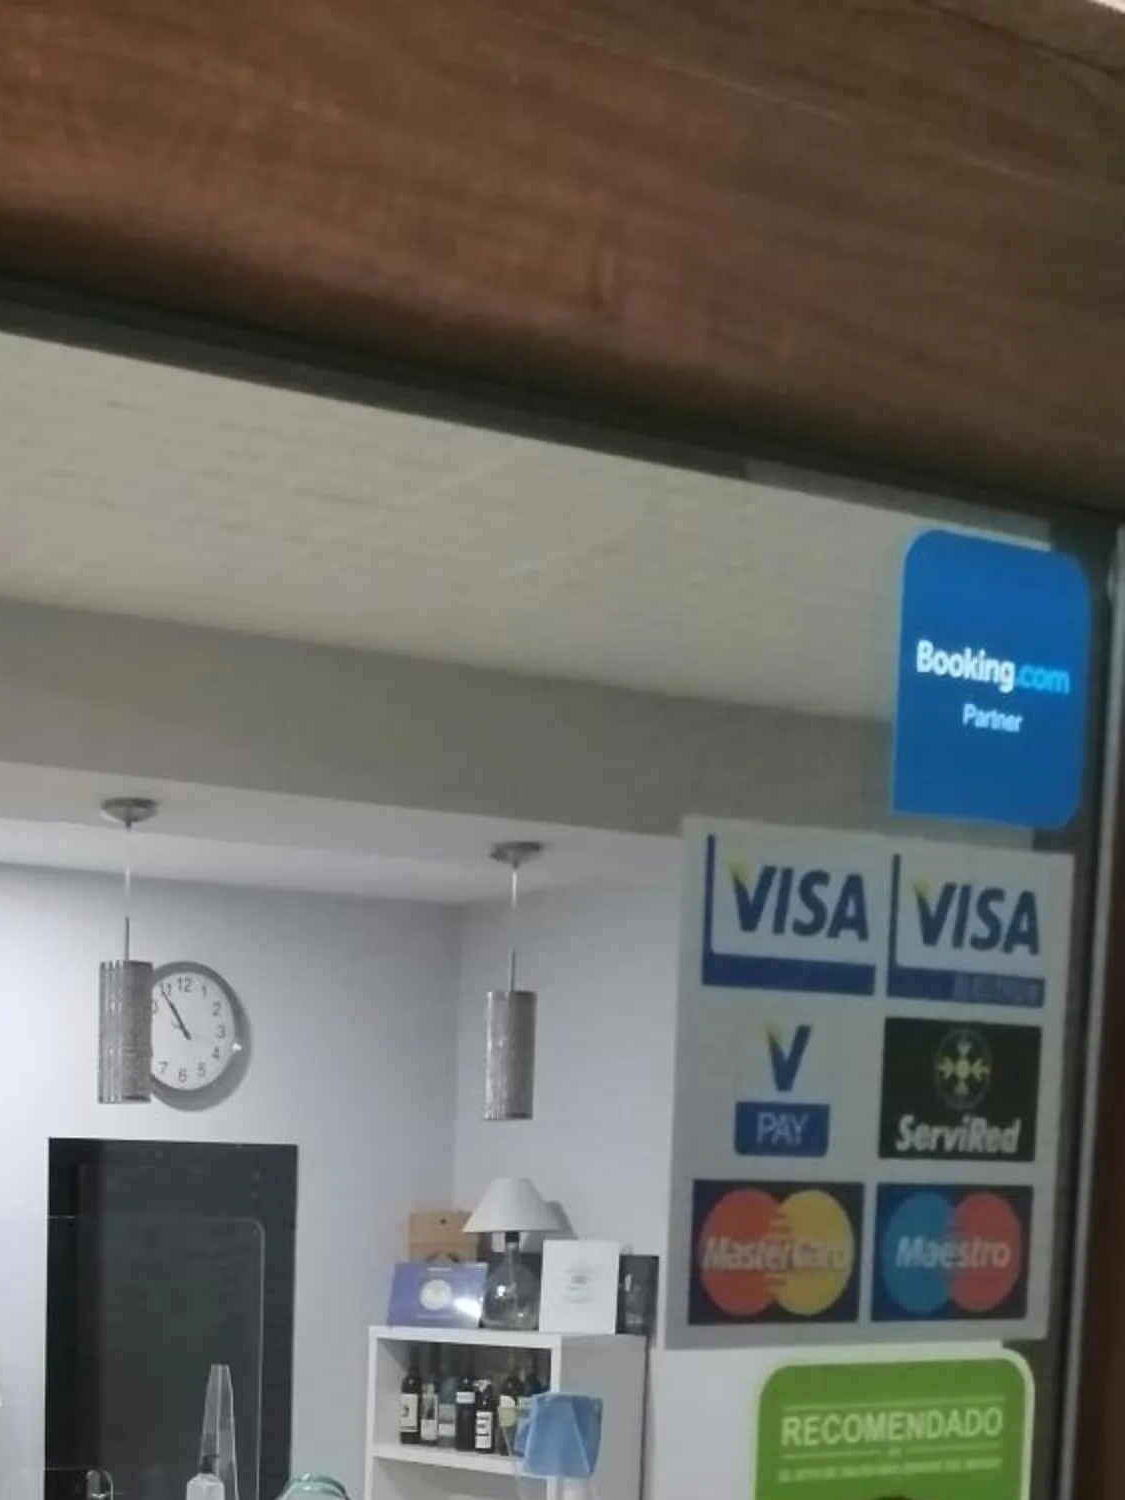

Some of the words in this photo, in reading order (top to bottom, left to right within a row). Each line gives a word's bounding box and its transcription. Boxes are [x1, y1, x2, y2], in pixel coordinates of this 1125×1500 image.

[916, 638, 1070, 694] Booking.com
[962, 703, 1023, 732] Partner
[730, 864, 869, 943] VISA
[913, 880, 1040, 956] VISA
[756, 1110, 808, 1147] PAY
[896, 1114, 1022, 1155] ServiRed
[896, 1234, 1012, 1271] Maestro
[781, 1407, 1004, 1448] RECOMENDADO
